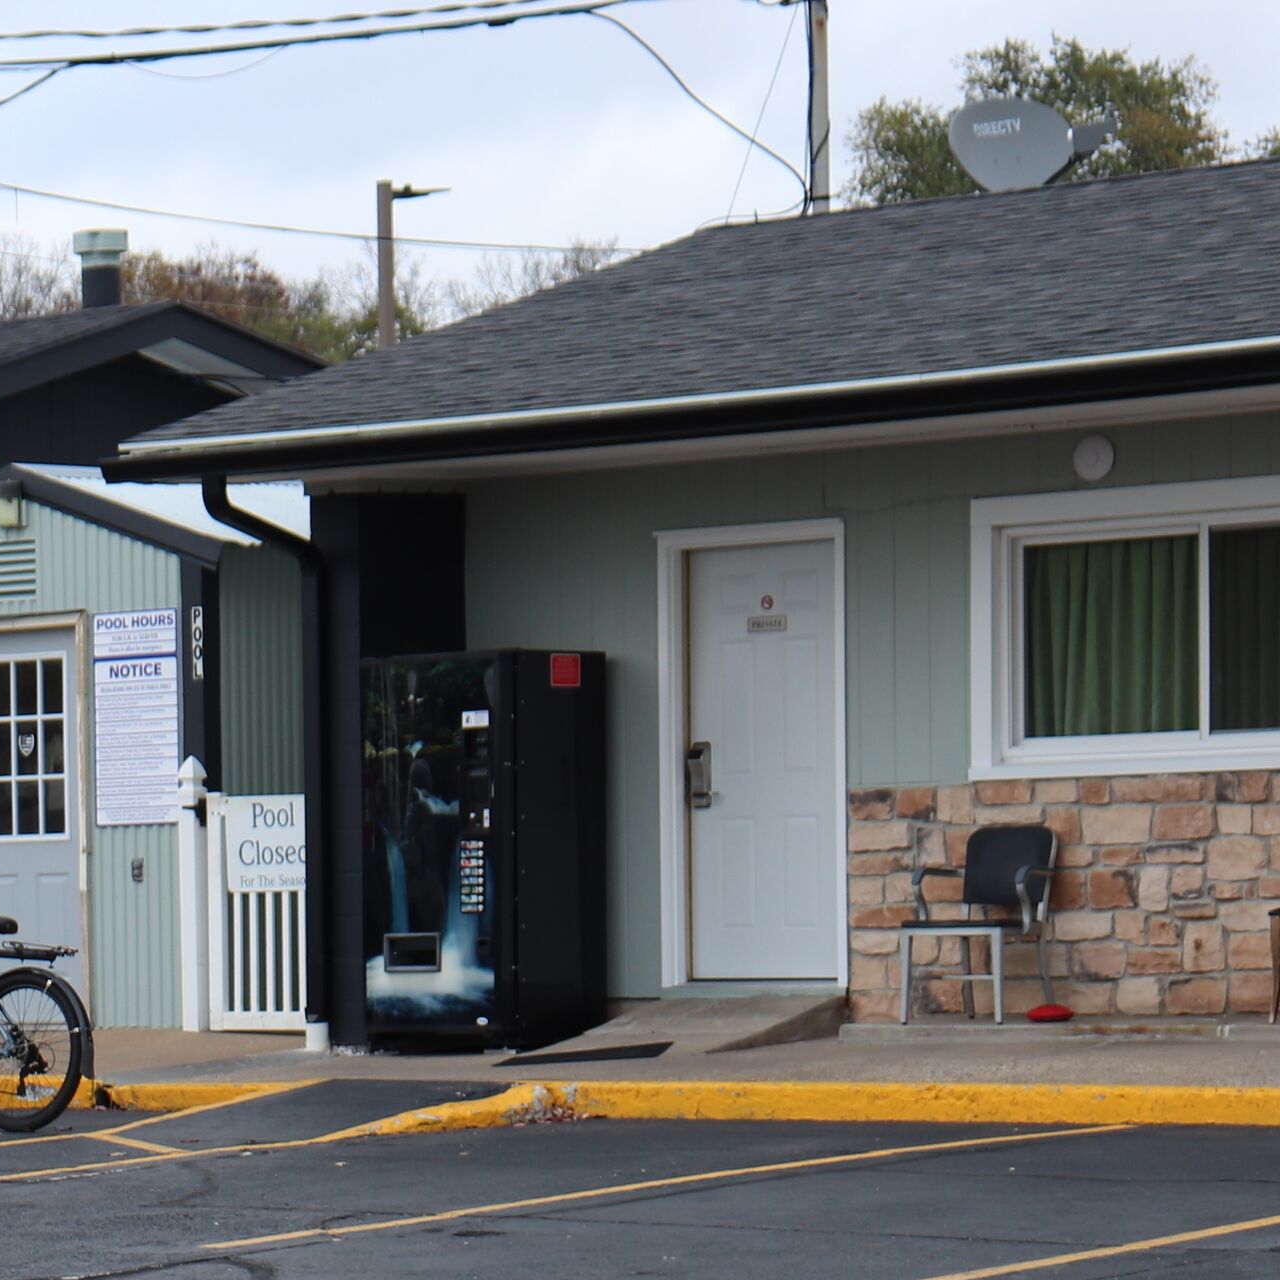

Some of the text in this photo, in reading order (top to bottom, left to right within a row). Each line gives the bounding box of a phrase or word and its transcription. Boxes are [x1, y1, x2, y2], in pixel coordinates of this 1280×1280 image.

[973, 118, 1020, 136] DIRECTV
[96, 613, 174, 630] POOL HOURS
[193, 608, 202, 677] POOL
[109, 662, 162, 679] NOTICE
[251, 801, 295, 828] Pool
[241, 874, 306, 888] For The Seaso
